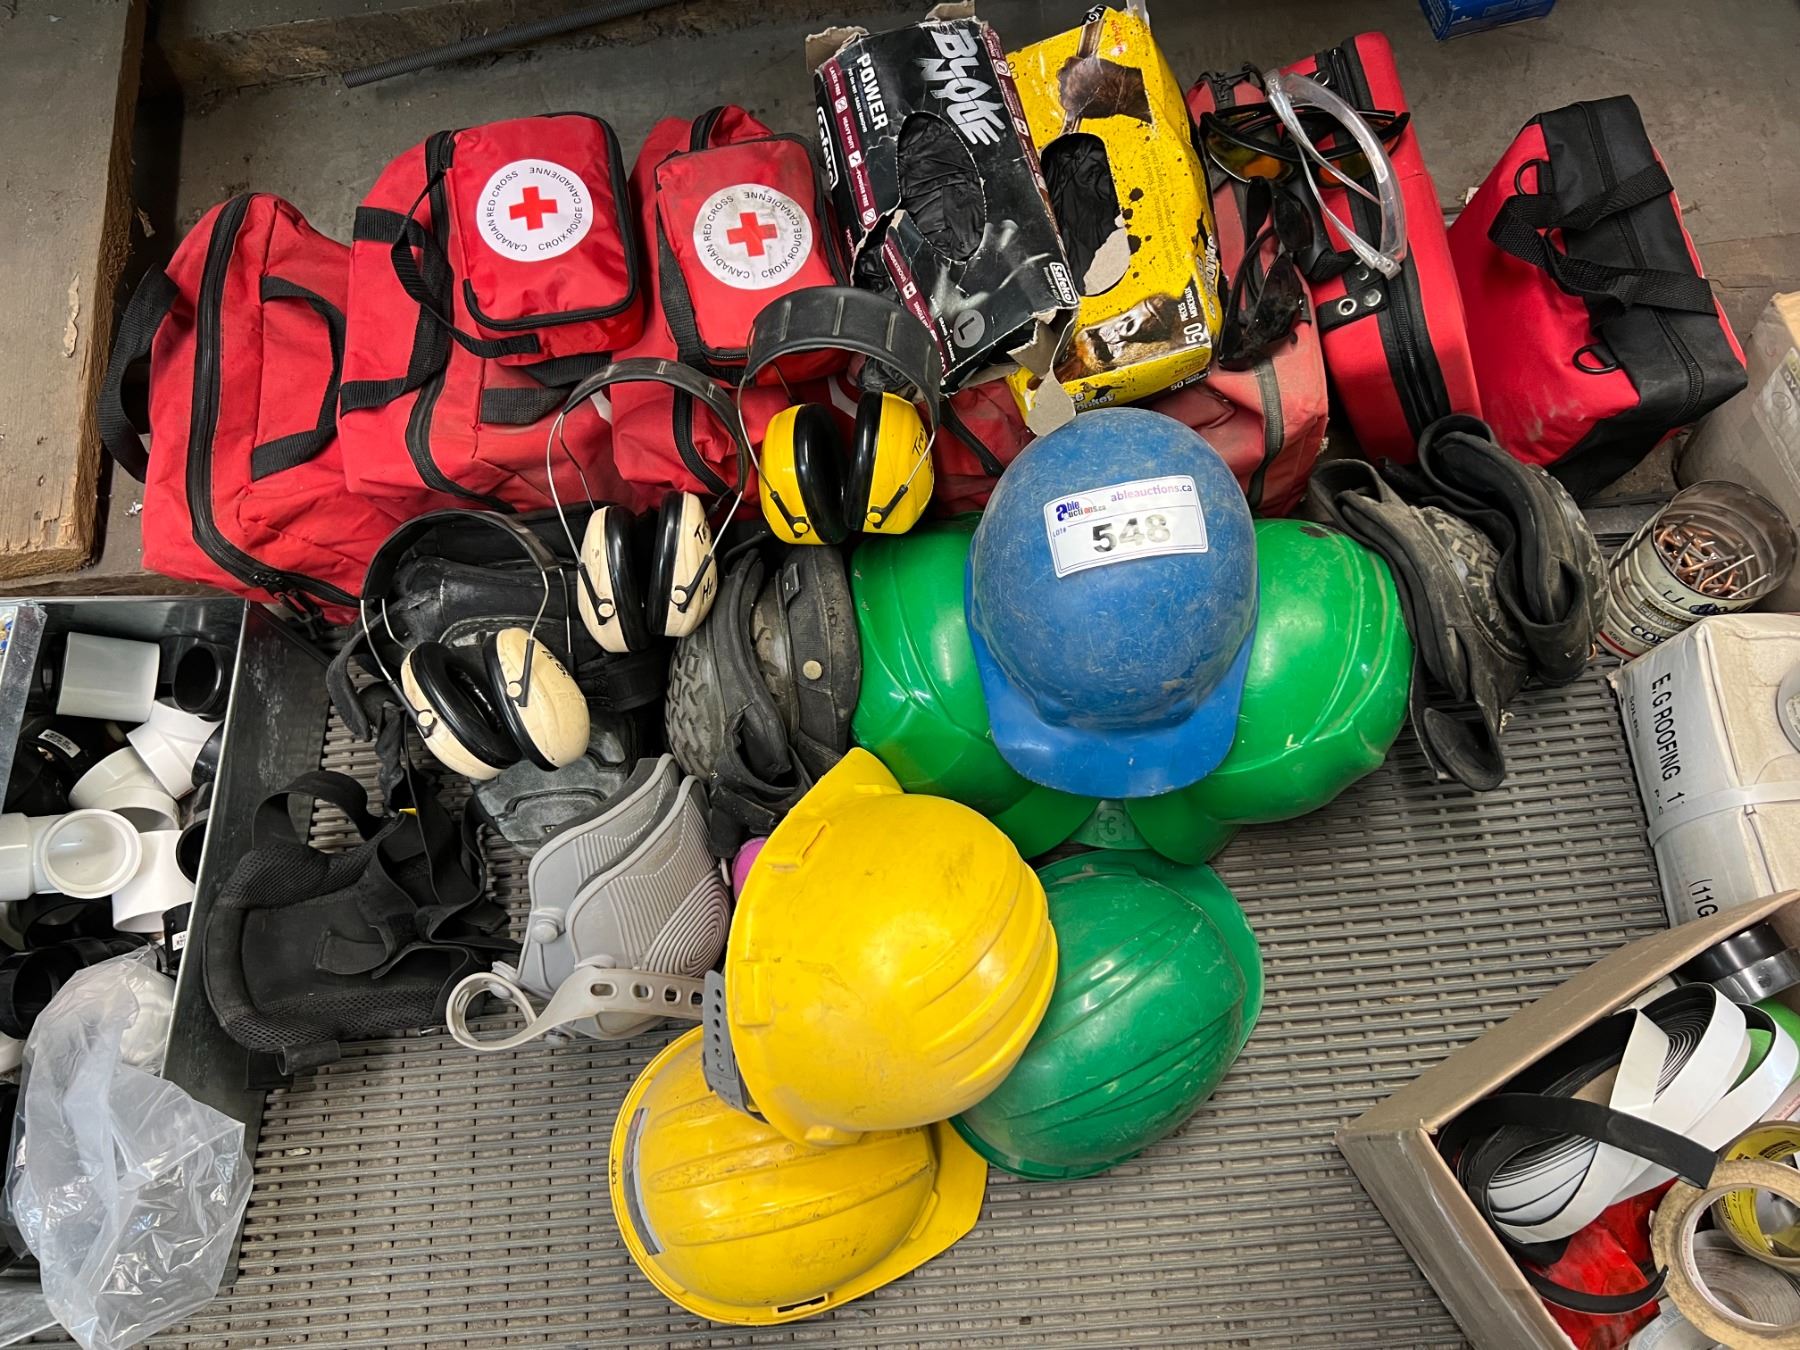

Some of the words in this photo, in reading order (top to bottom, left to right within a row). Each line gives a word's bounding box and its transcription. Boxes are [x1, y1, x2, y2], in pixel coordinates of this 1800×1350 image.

[834, 83, 842, 96] FREE
[842, 116, 852, 136] HEAVY
[847, 135, 855, 150] DUTY
[492, 170, 519, 198] CROSS
[529, 166, 582, 204] CANADIENNE
[486, 199, 496, 217] RED
[707, 195, 734, 222] CROSS
[744, 191, 799, 226] CANADIENNE
[862, 194, 870, 207] FREE
[488, 219, 528, 252] CANADIAN
[703, 223, 712, 242] RED
[706, 244, 750, 279] CANADIAN
[1053, 265, 1072, 300] Safeko
[1184, 286, 1199, 319] MORCEAUX
[958, 317, 975, 341] L
[1183, 322, 1204, 345] 50
[1111, 483, 1192, 502] ableauctions.ca
[1092, 514, 1171, 553] 548
[1653, 705, 1681, 782] ROOFING
